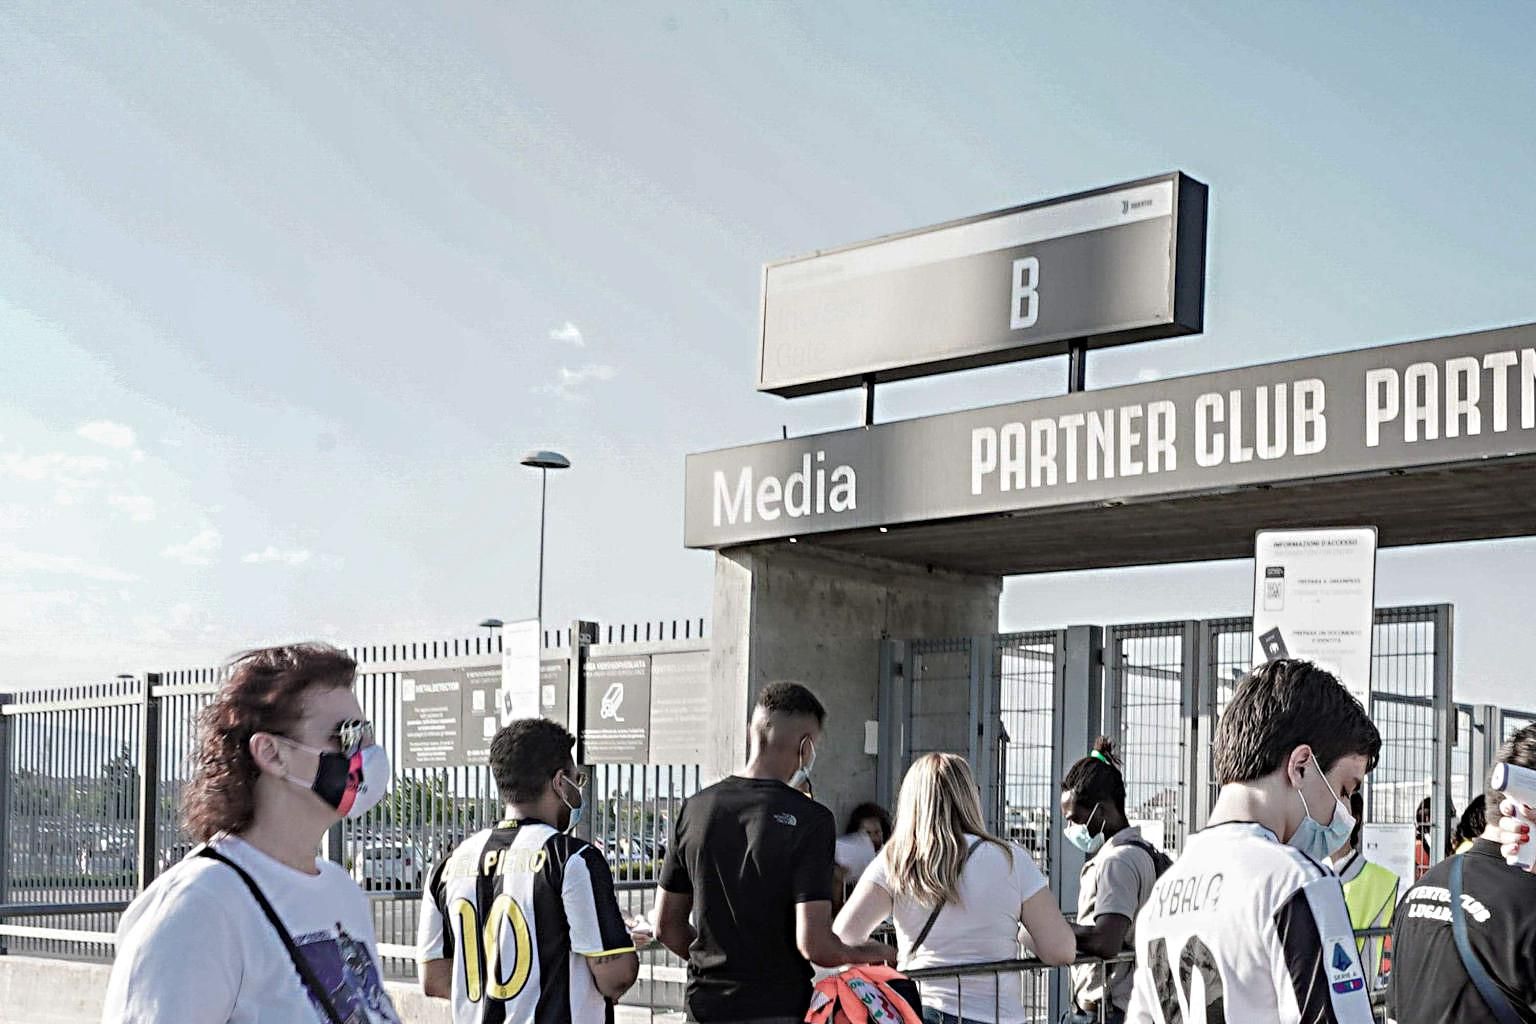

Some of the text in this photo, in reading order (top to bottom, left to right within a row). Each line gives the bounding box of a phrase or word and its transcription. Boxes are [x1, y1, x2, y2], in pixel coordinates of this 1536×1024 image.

[1009, 257, 1040, 330] B
[971, 400, 1177, 496] PARTNER
[1194, 378, 1327, 467] CLUB
[712, 453, 858, 526] Media
[451, 894, 534, 1004] 10
